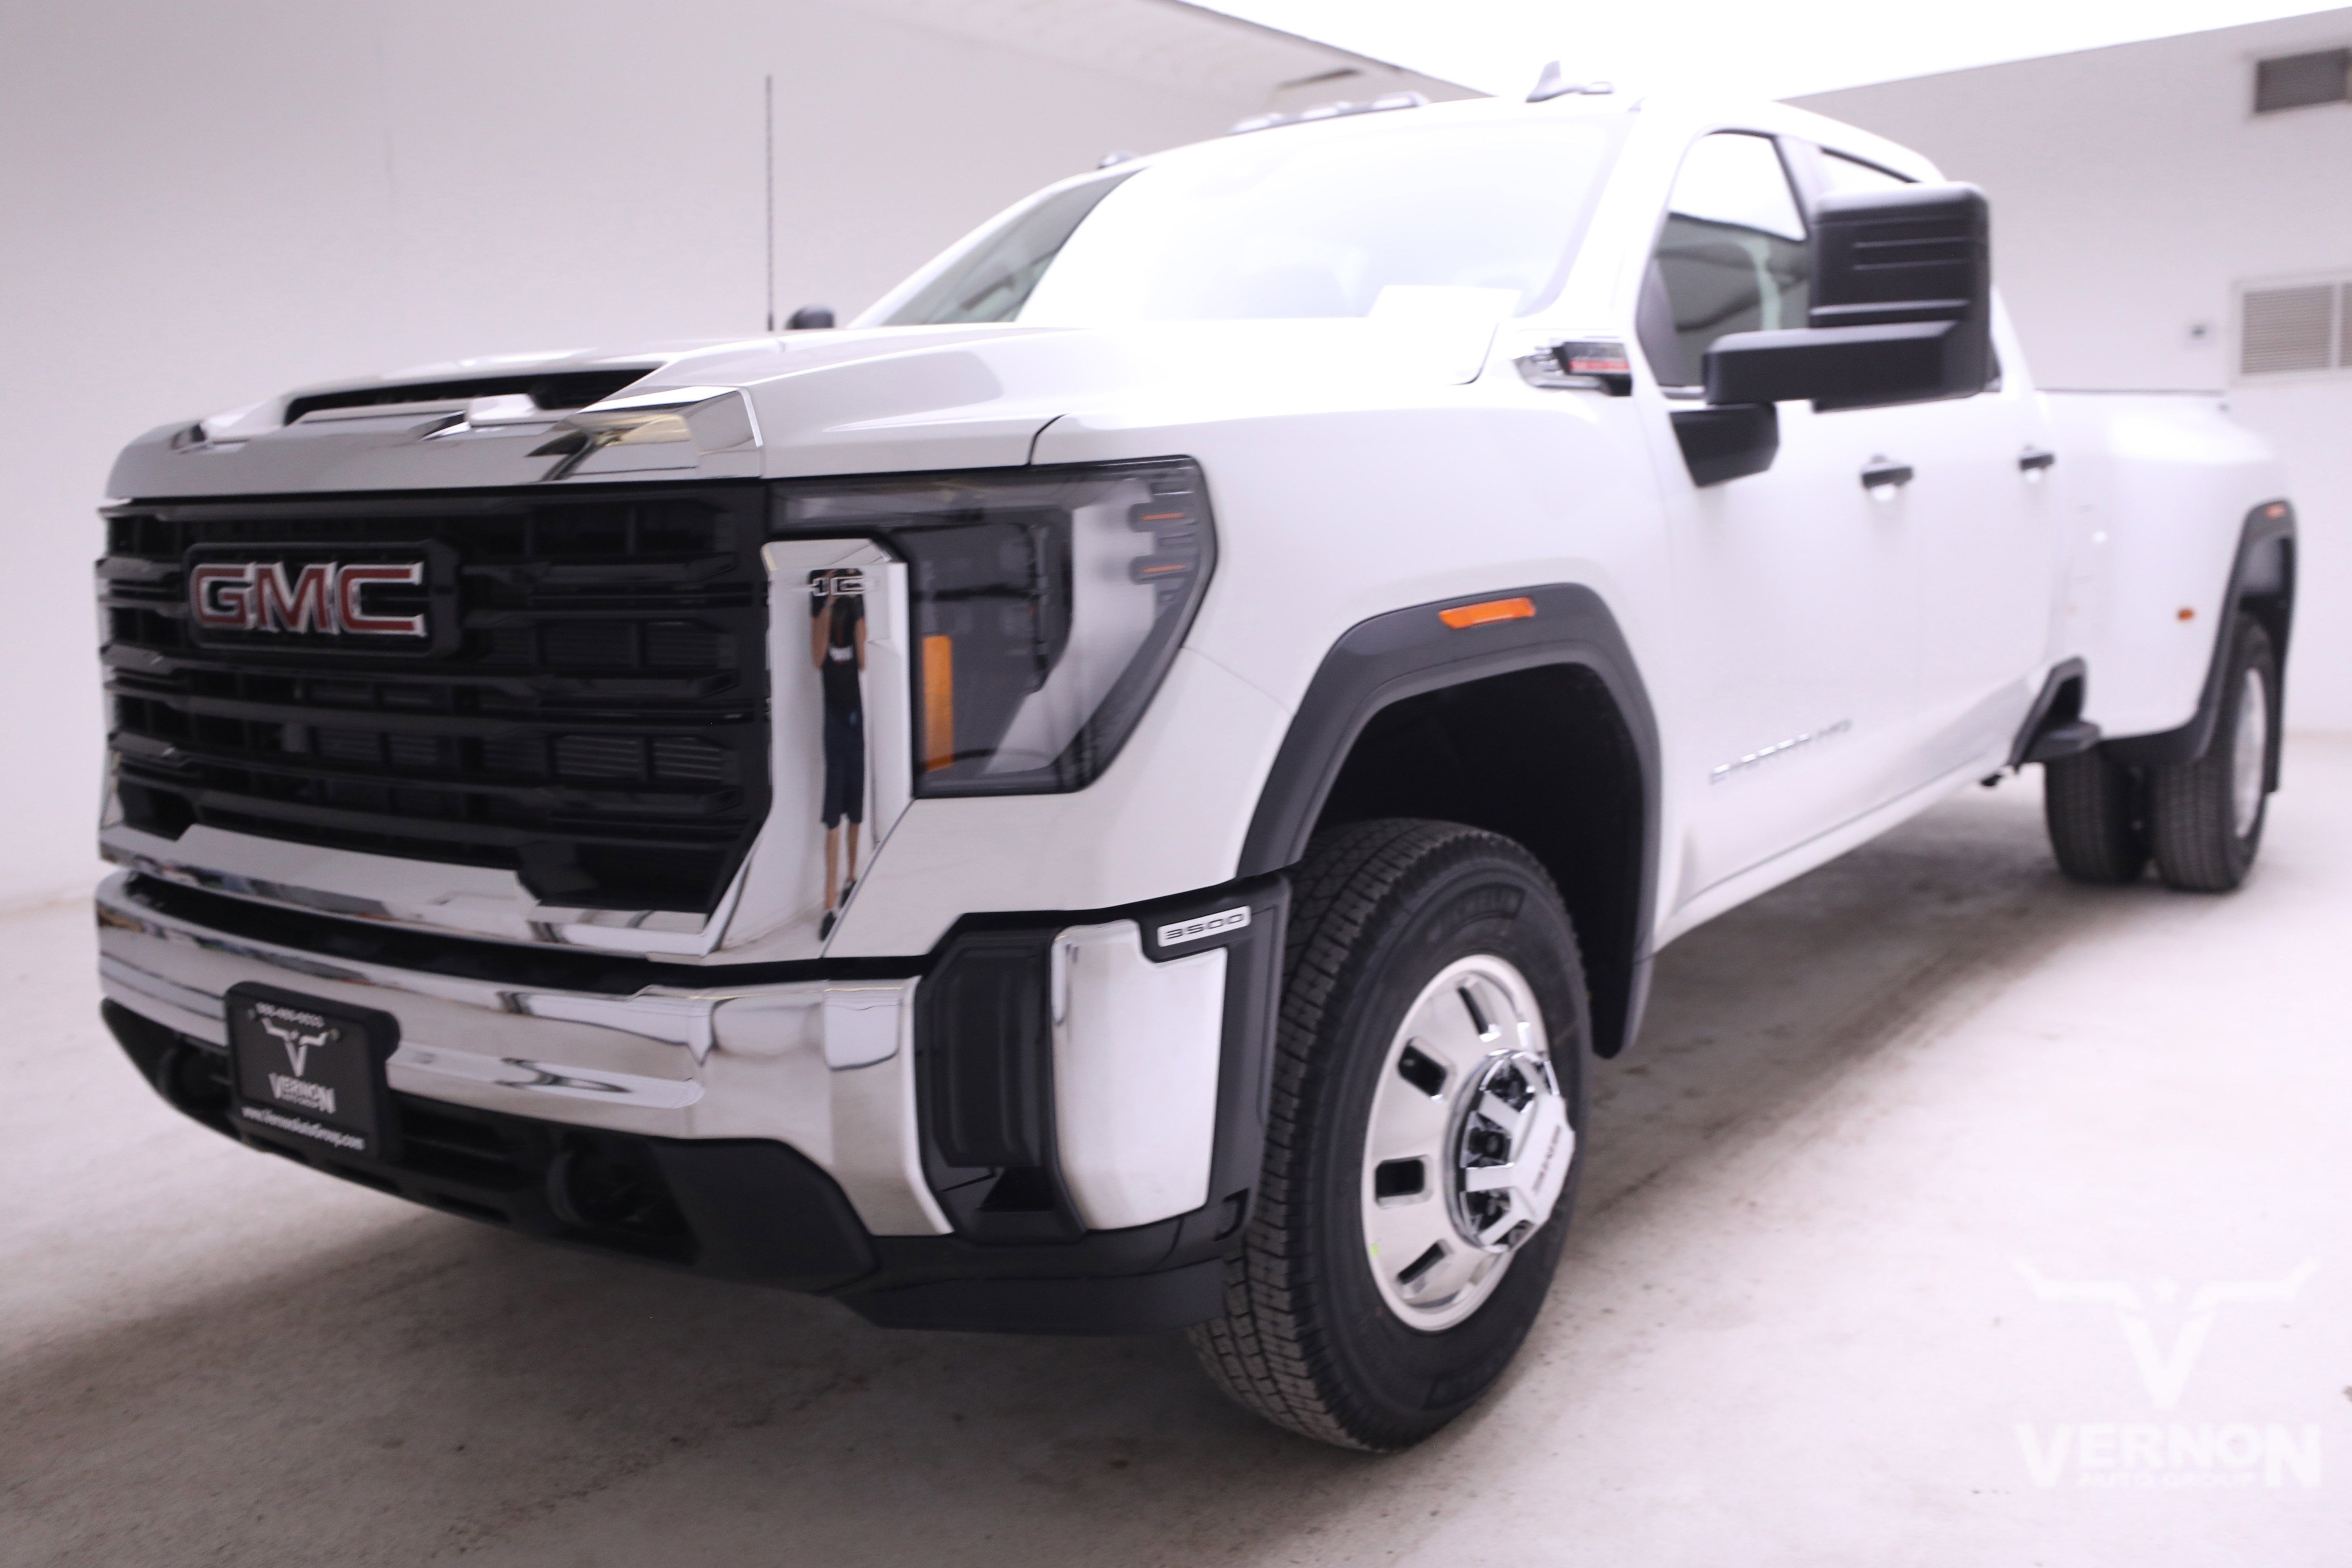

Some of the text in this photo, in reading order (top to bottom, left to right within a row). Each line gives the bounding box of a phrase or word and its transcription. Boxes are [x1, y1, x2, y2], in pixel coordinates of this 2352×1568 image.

[189, 561, 427, 638] GMC
[1164, 913, 1245, 940] 3500
[268, 1072, 336, 1114] VERNON
